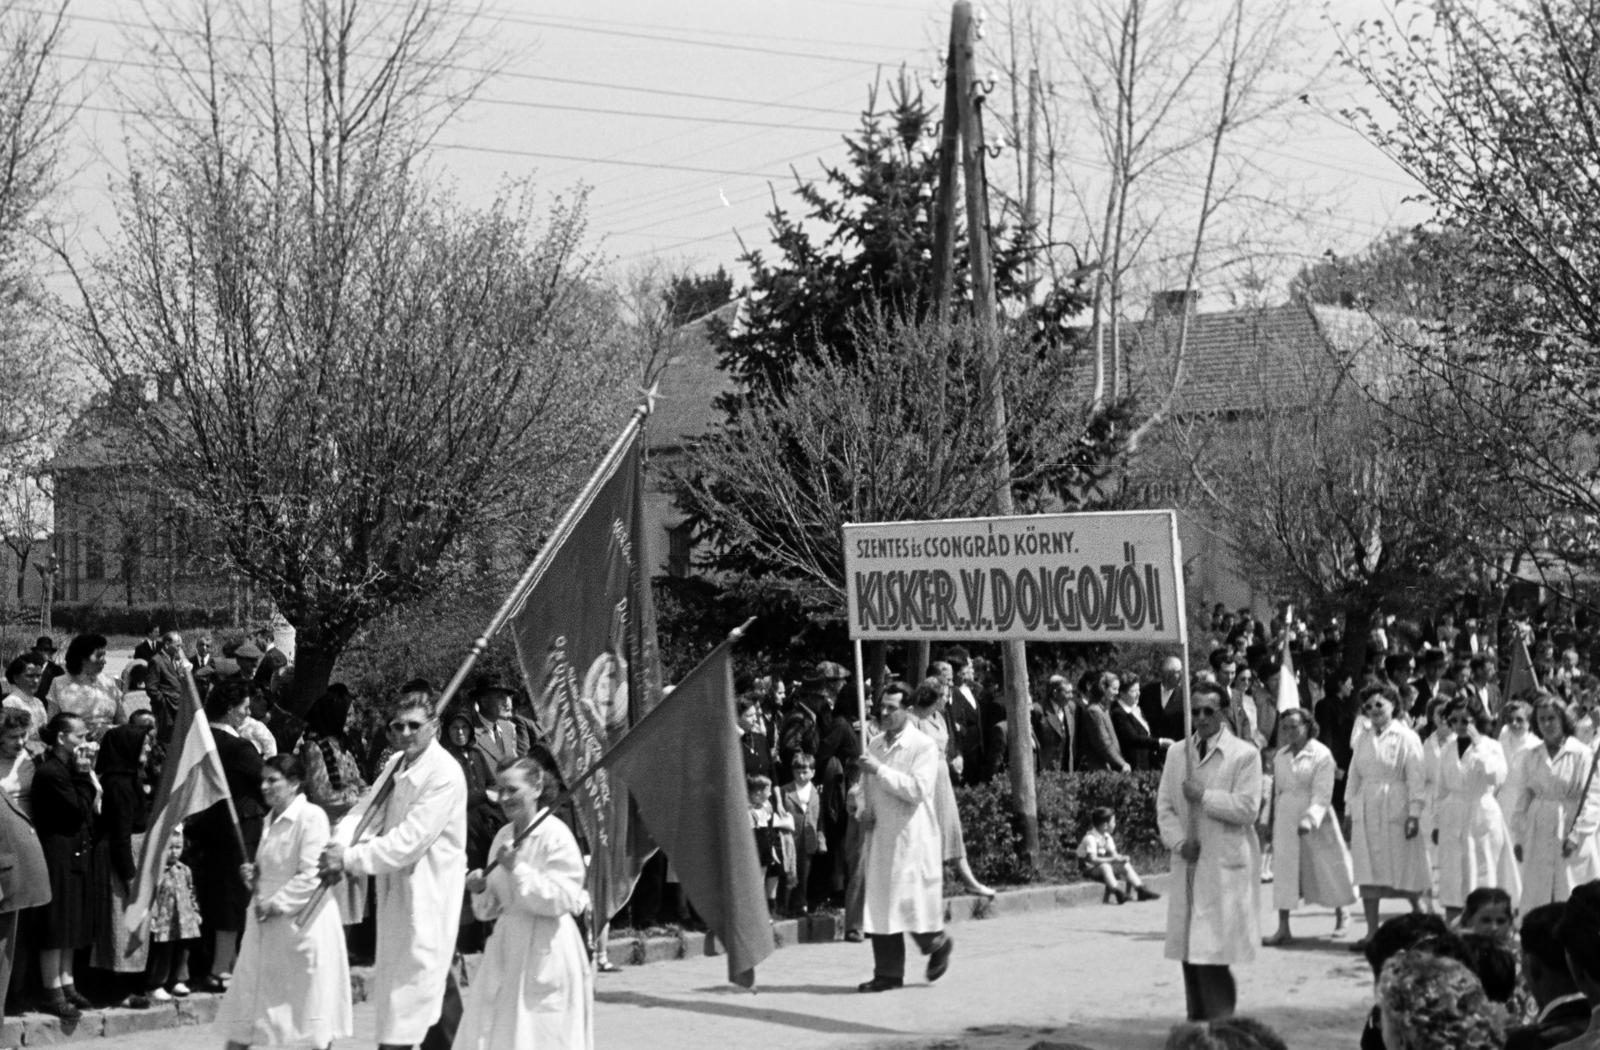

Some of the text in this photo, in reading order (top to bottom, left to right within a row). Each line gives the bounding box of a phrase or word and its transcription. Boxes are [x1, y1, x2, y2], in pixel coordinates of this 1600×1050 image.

[856, 538, 910, 558] SZENTES
[924, 523, 1010, 558] CSONGRÁD
[1014, 526, 1079, 555] KÖRNY.
[989, 541, 1164, 632] DOLGOZÓI
